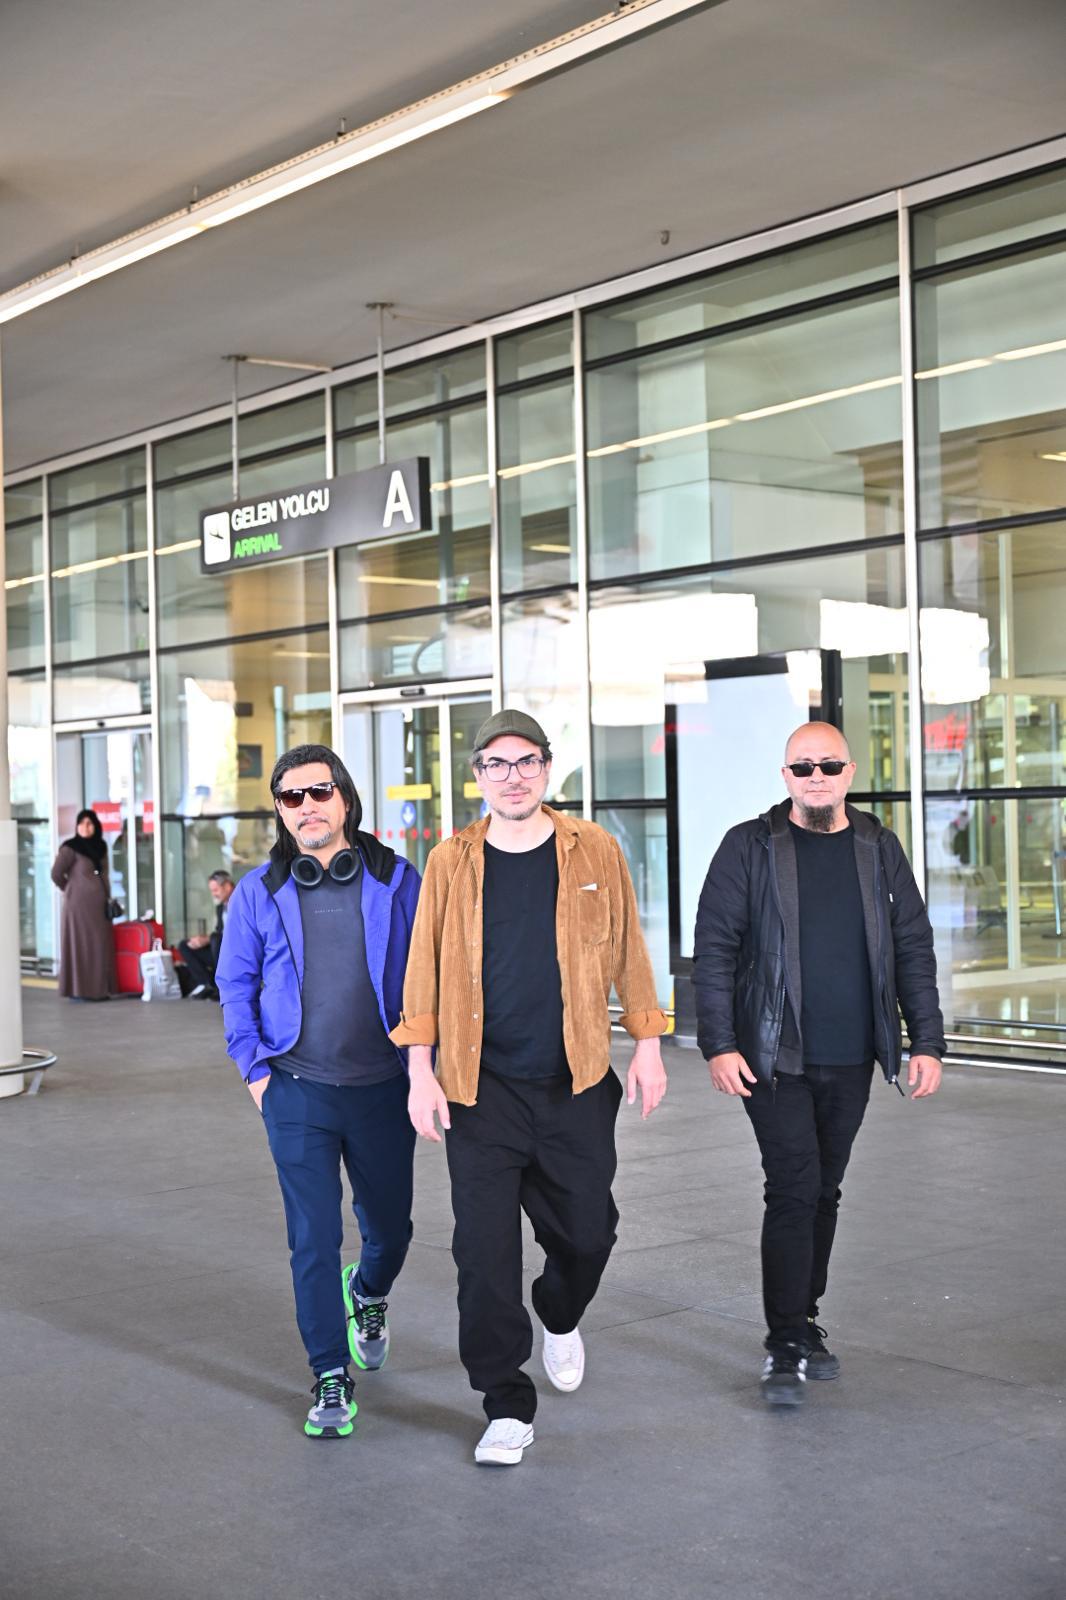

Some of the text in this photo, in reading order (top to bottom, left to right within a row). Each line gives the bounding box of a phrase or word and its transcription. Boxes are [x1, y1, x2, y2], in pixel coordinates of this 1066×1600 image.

[231, 487, 330, 531] GELEN YOLCU
[382, 470, 414, 528] A
[233, 532, 282, 559] ARRIVAL
